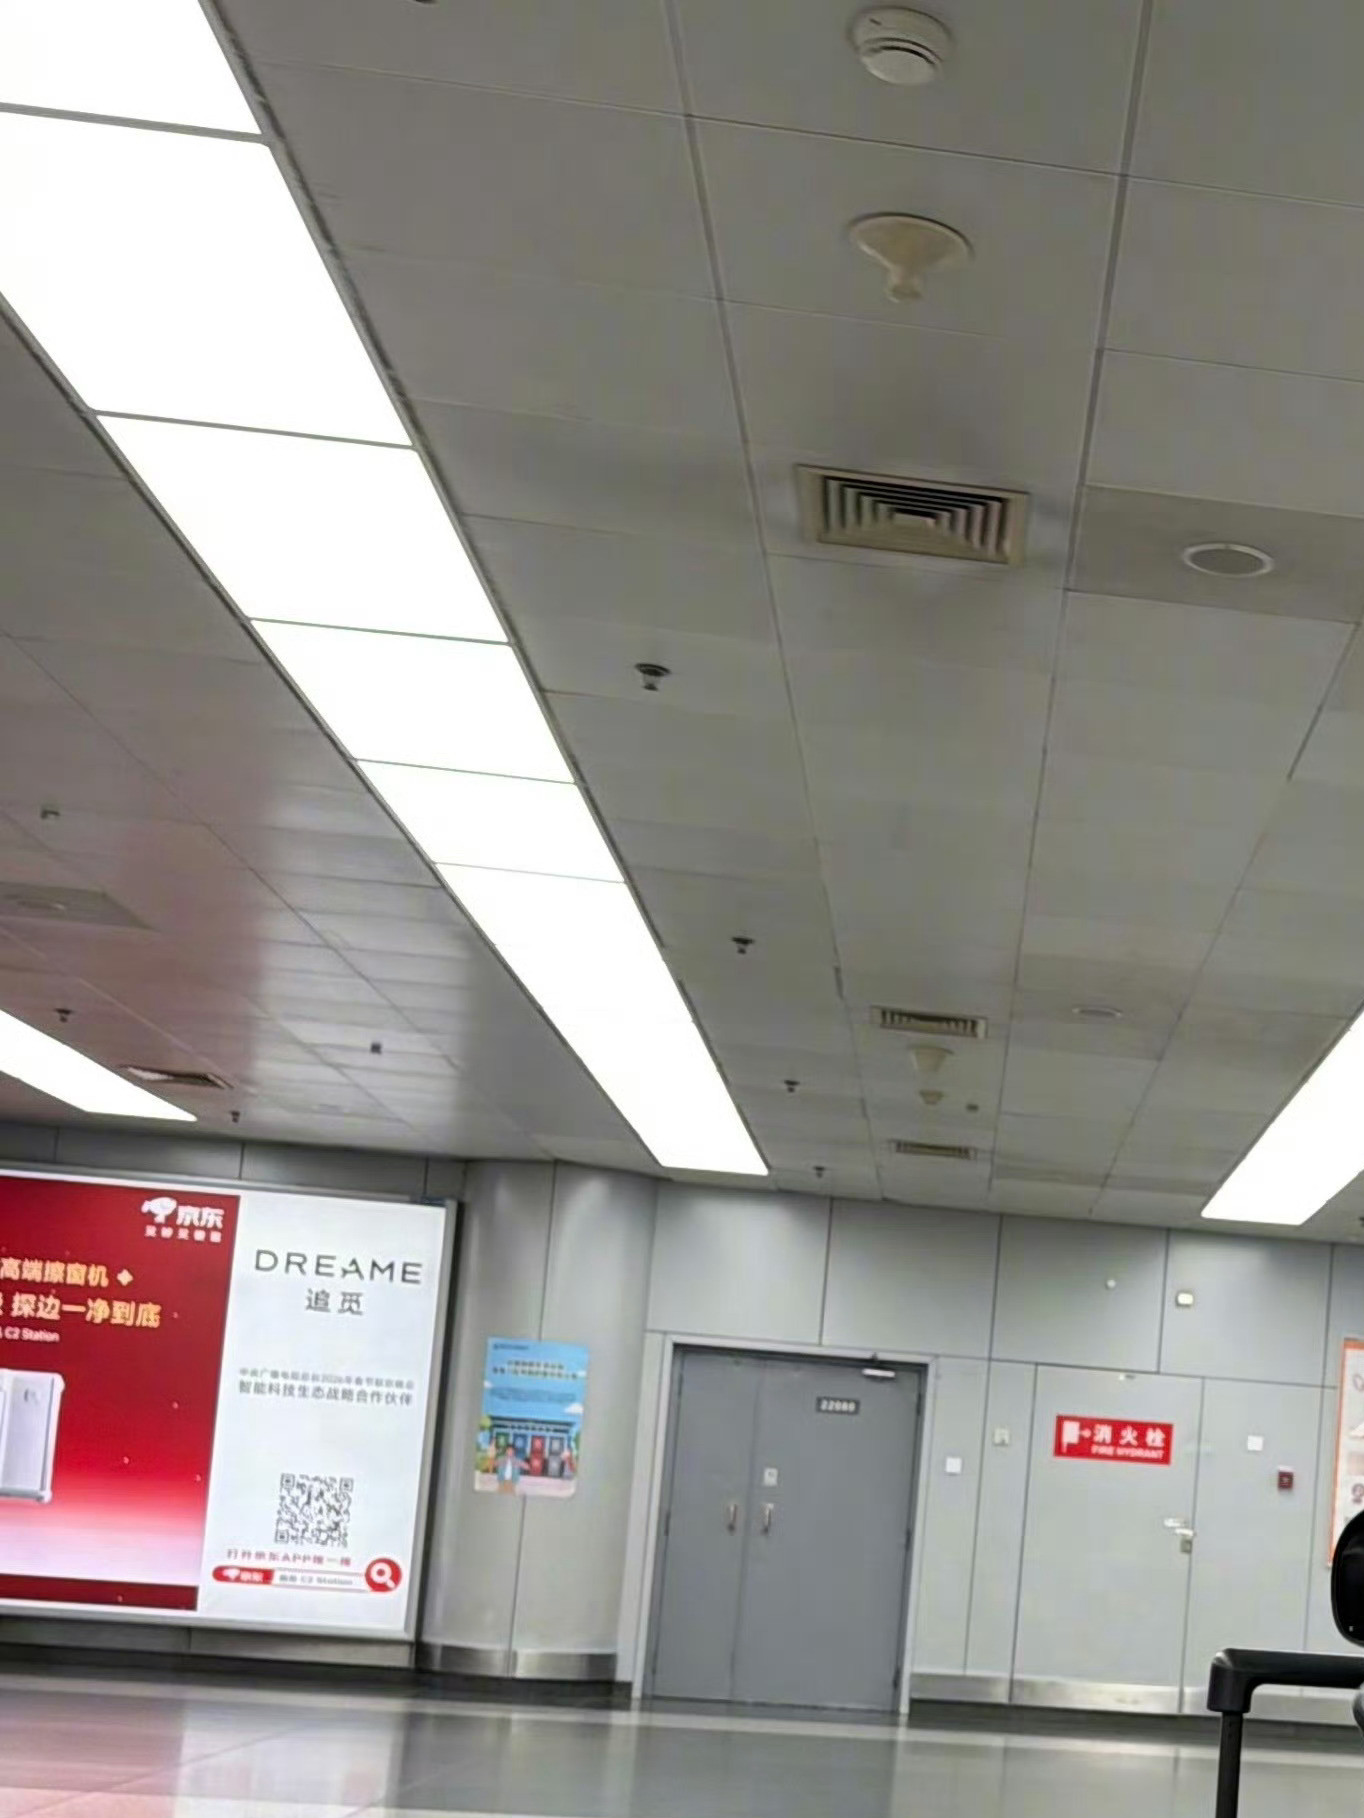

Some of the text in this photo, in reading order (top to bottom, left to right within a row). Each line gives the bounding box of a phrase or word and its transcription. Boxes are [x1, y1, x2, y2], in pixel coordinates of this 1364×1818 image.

[176, 1205, 225, 1230] 京东
[254, 1249, 423, 1285] DREAME
[305, 1287, 364, 1317] 追觅
[21, 1327, 60, 1343] Station
[1093, 1423, 1166, 1447] 消火栓
